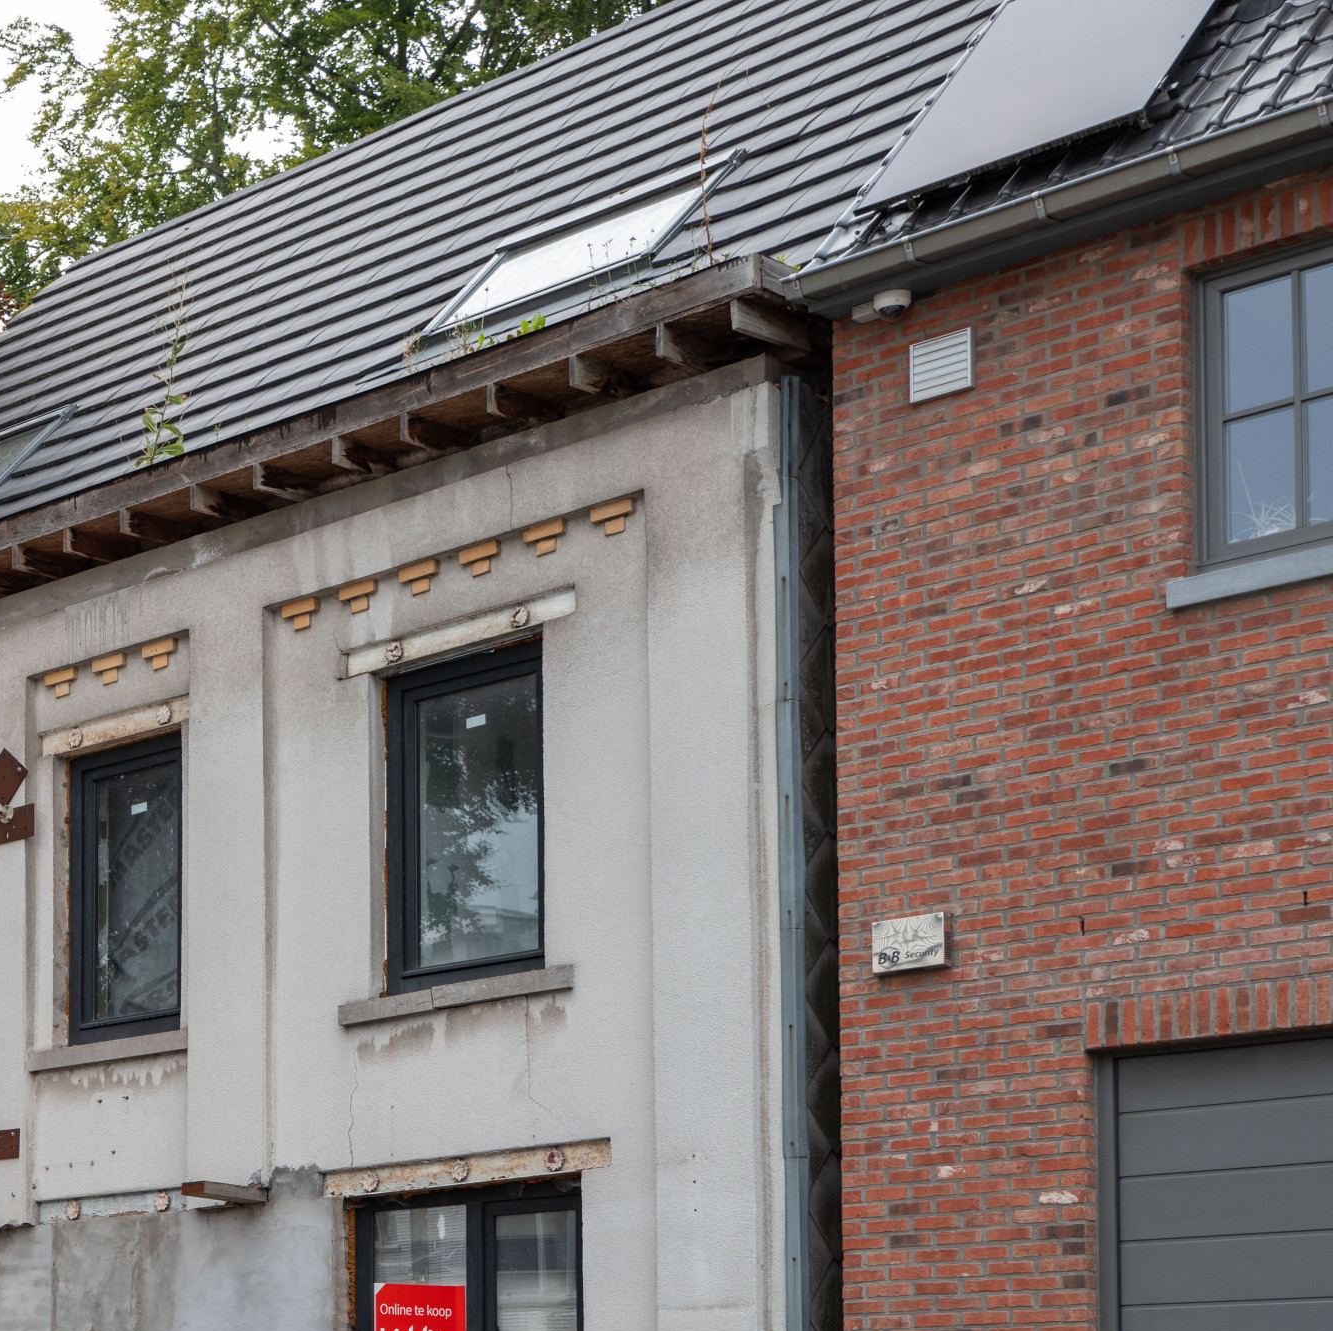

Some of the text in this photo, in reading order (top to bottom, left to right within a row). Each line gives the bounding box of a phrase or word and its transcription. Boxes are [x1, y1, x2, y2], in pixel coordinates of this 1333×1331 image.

[878, 949, 939, 965] B&B Security
[380, 1303, 452, 1320] Online te koop
